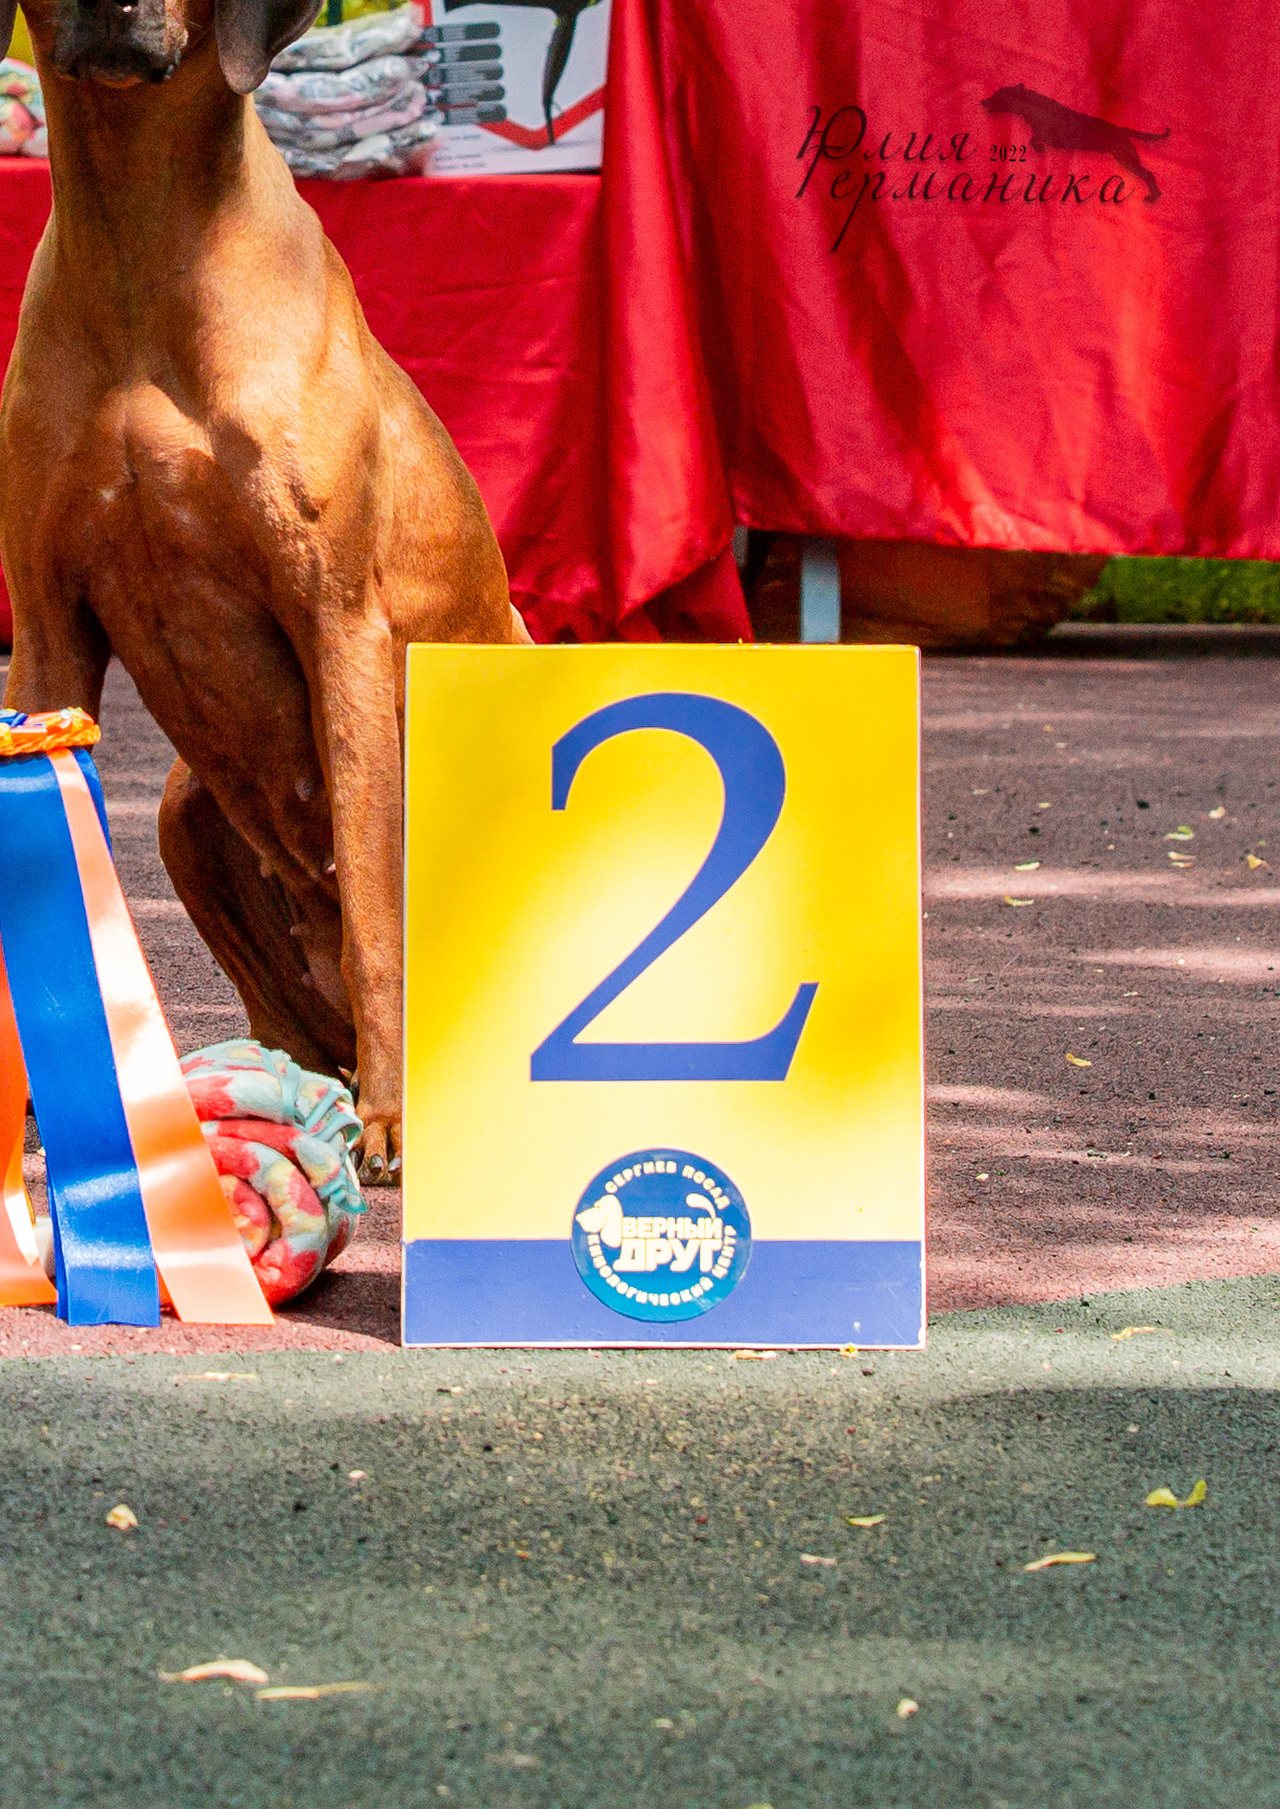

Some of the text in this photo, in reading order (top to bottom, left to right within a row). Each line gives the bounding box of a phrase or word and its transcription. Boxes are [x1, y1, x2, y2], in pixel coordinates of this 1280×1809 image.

[529, 692, 820, 1083] 2
[604, 1160, 731, 1210] СЕРГИЕВ ПОСАД
[587, 1224, 737, 1307] КИНОЛОГИЧЕСКИЙ ЦЕНТР
[612, 1238, 723, 1272] ДРУГ
